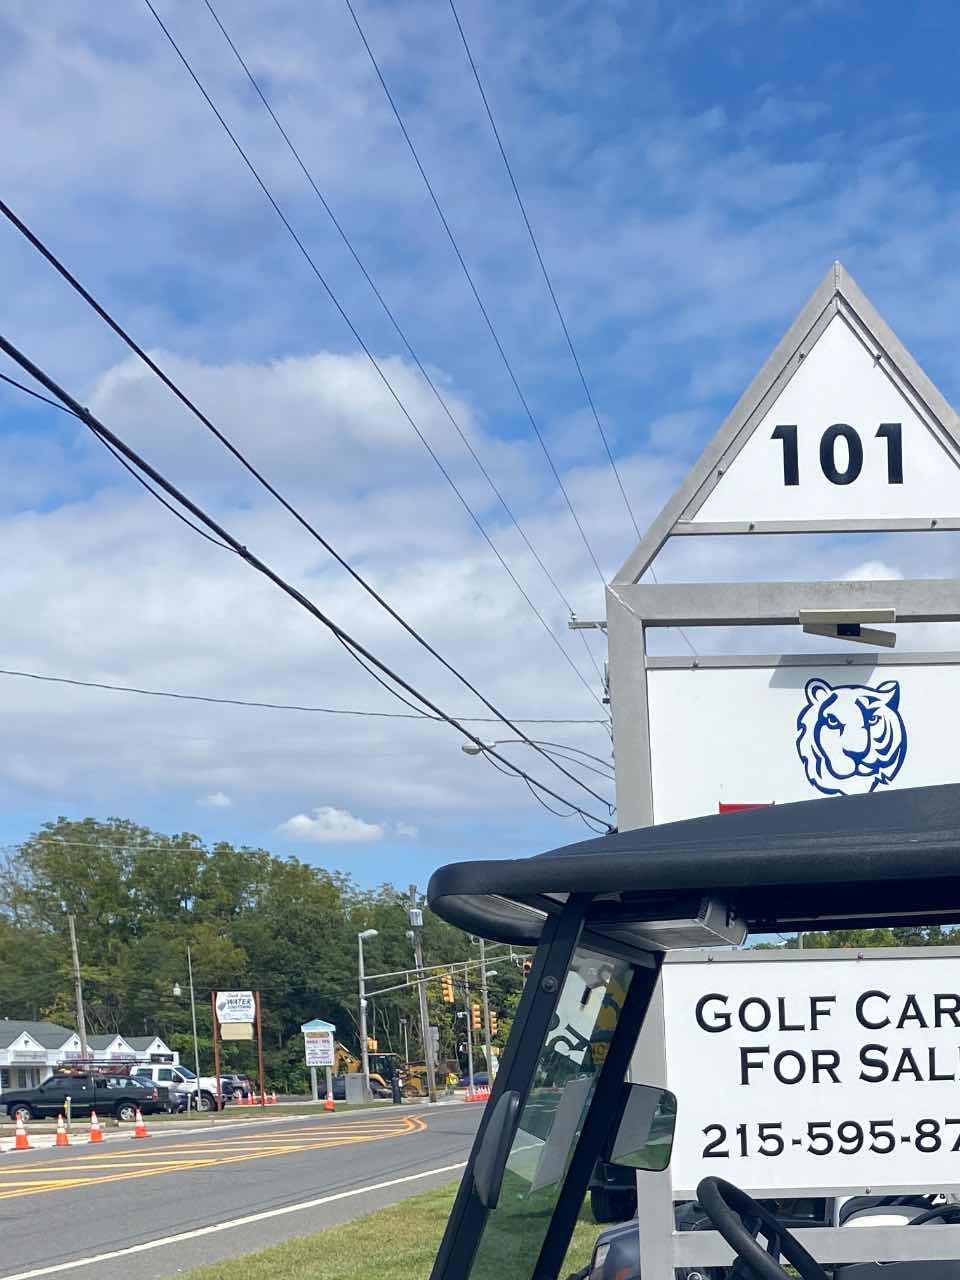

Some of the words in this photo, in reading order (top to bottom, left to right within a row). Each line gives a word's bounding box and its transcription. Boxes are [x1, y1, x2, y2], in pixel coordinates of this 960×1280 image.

[770, 422, 904, 487] 101
[695, 993, 837, 1034] GOLF
[739, 1045, 842, 1086] FOR
